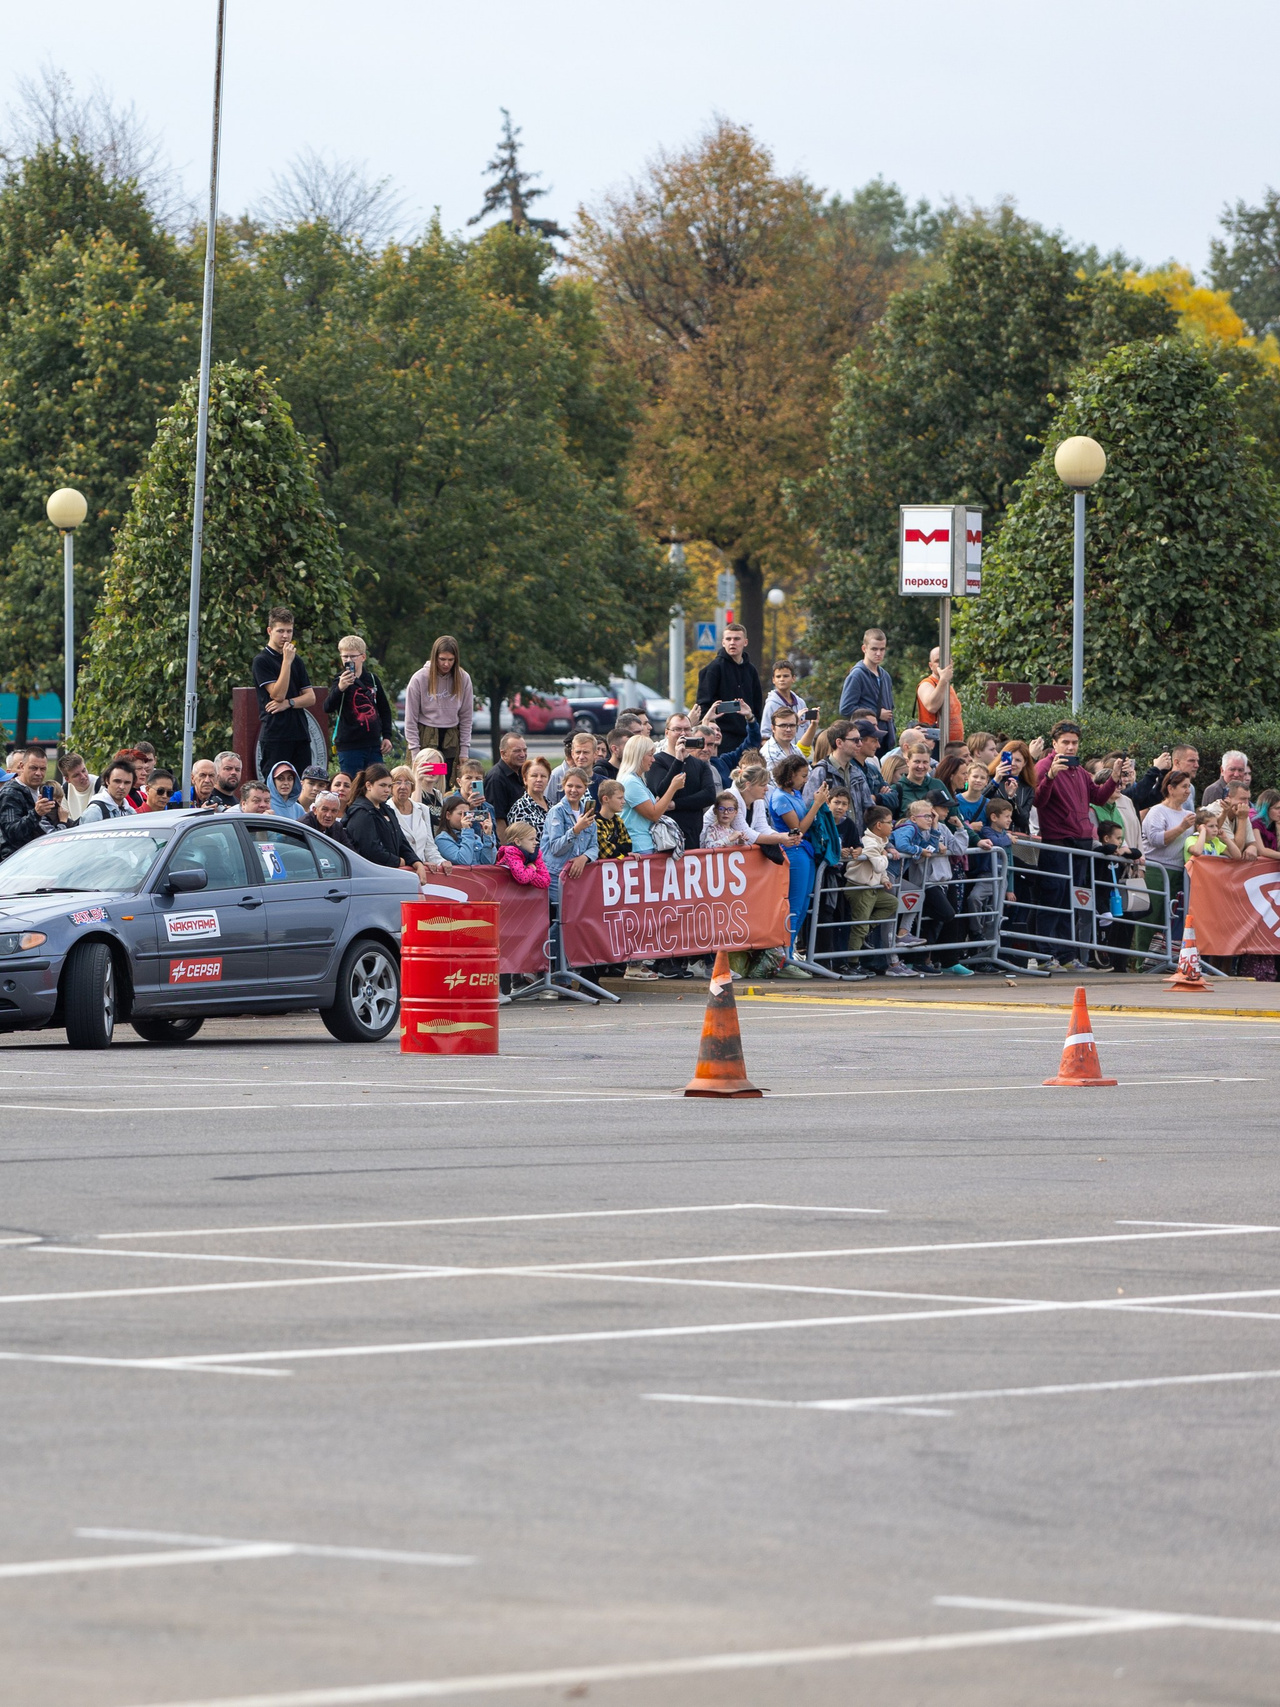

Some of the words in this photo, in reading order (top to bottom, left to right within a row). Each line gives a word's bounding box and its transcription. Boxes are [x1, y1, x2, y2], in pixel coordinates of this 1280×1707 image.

[269, 853, 282, 874] 6
[601, 851, 747, 906] BELARUS
[169, 918, 216, 932] NAKAYAMA
[603, 900, 750, 956] TRACTORS
[186, 963, 220, 977] CEPSA
